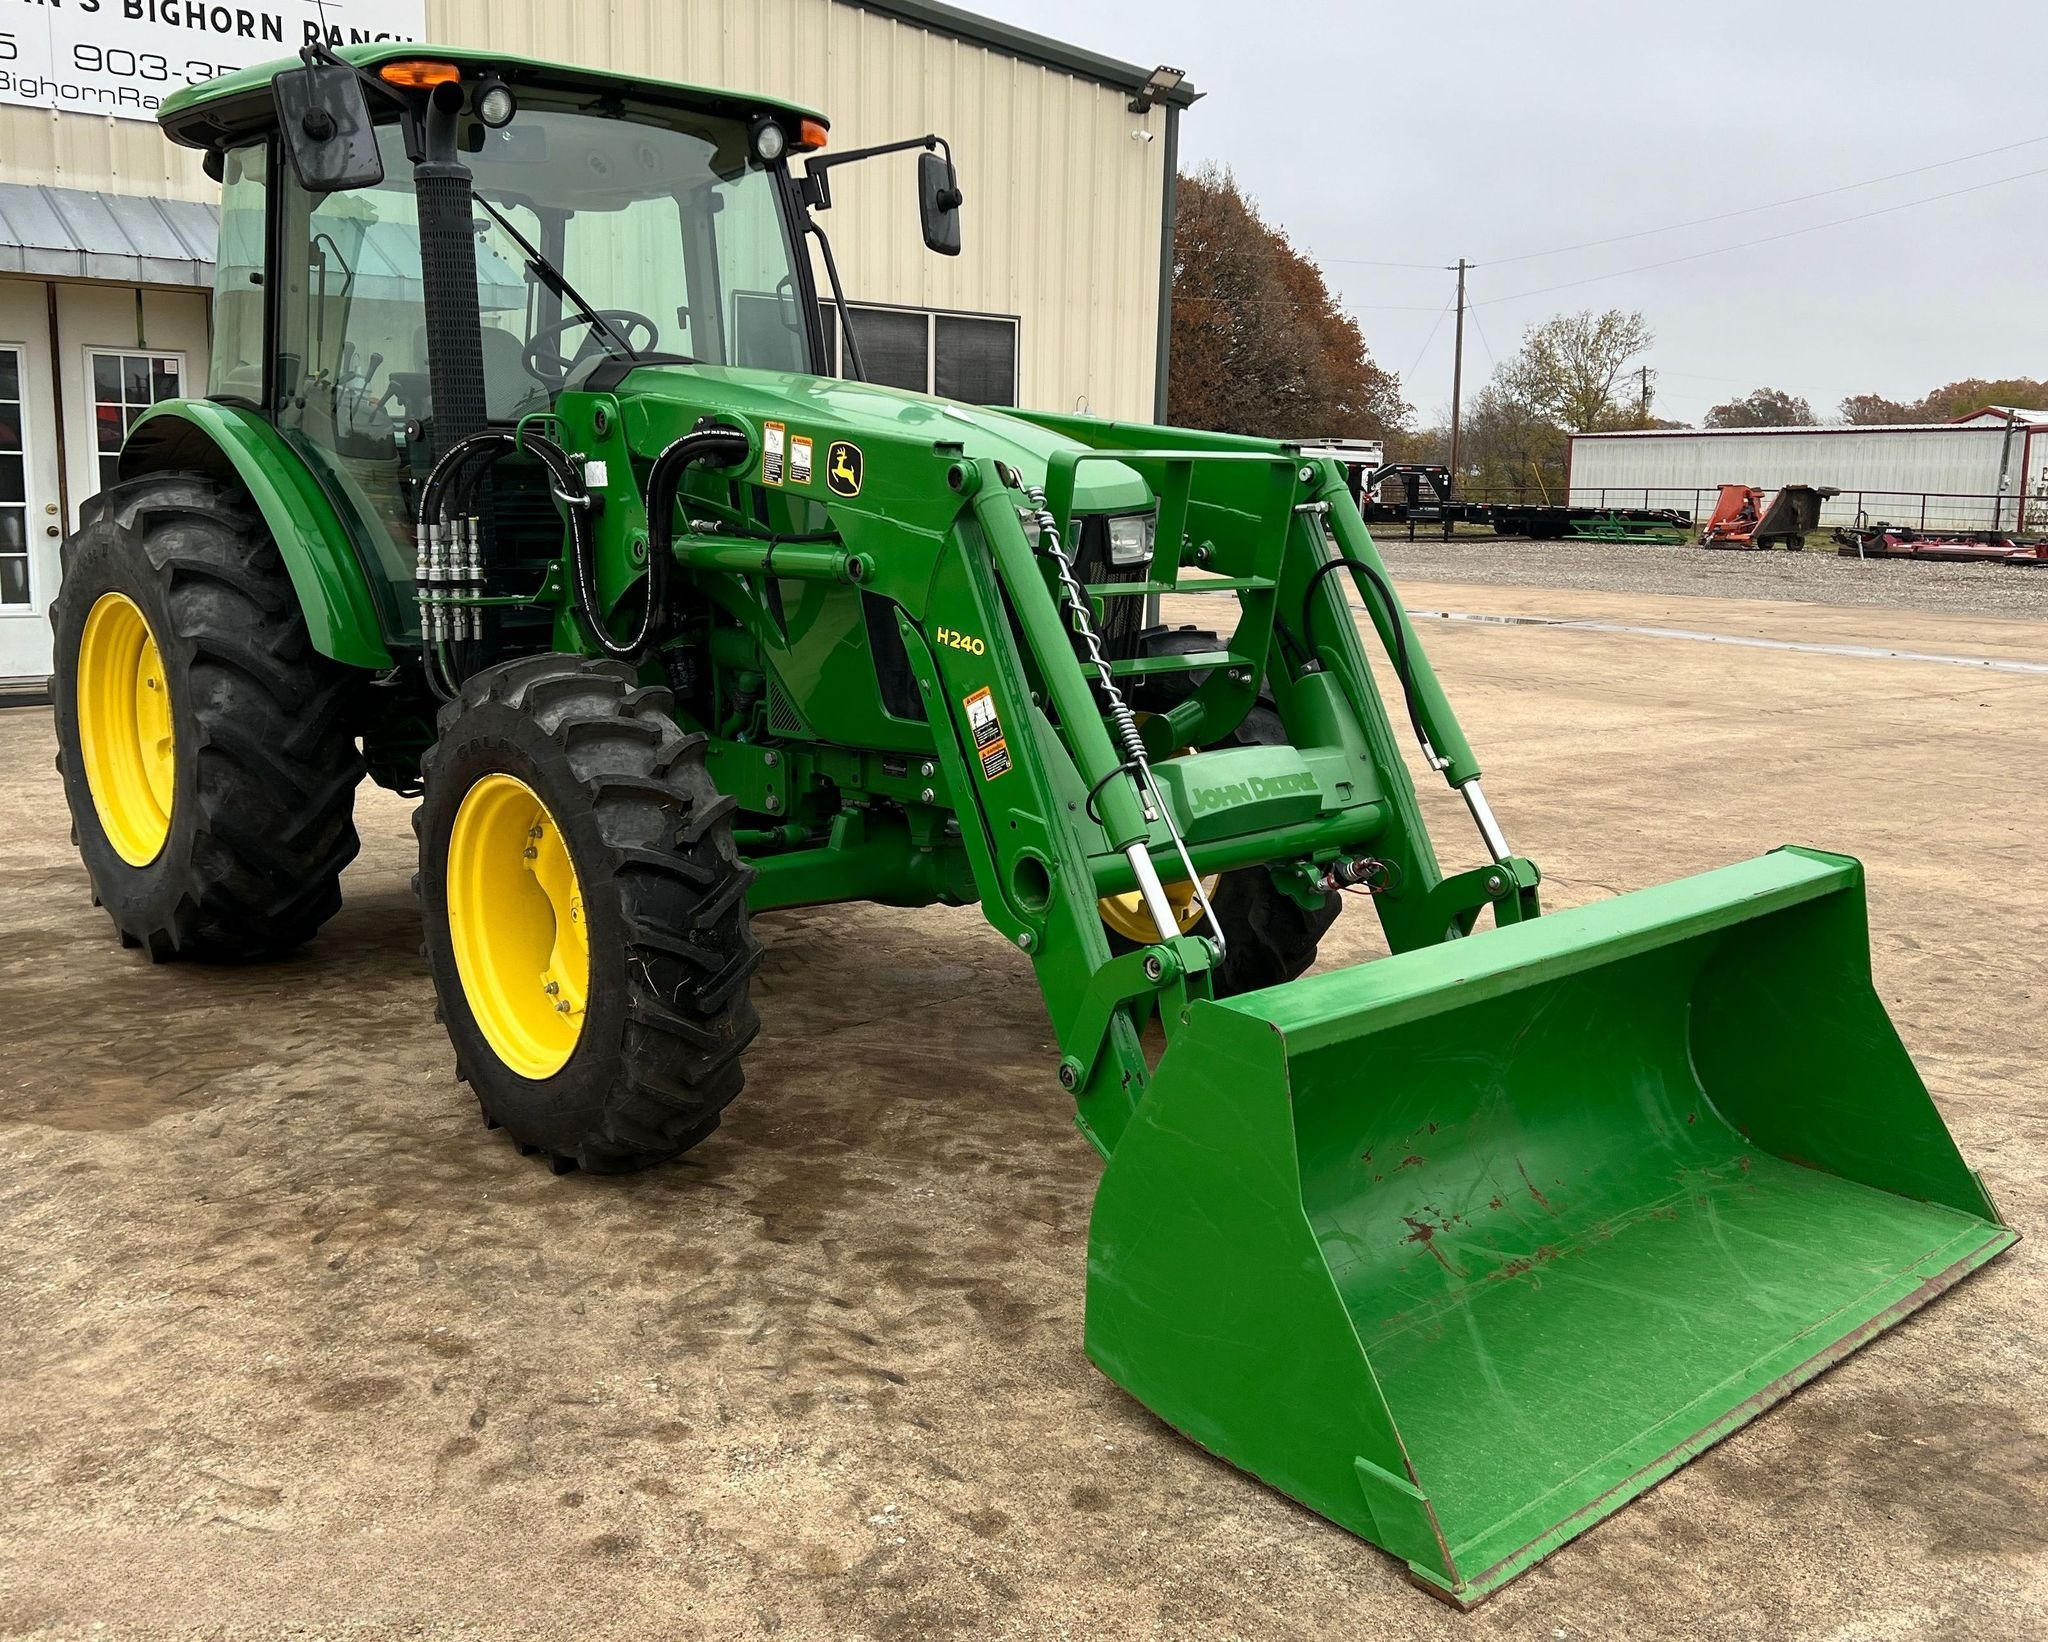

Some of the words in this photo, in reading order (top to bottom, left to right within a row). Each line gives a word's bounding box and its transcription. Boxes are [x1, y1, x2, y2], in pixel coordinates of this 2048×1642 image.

[123, 0, 283, 43] BIGHORN
[303, 20, 413, 47] RAN
[937, 626, 985, 656] H240
[1191, 782, 1252, 814] JOHN
[1247, 771, 1318, 799] DEERE
